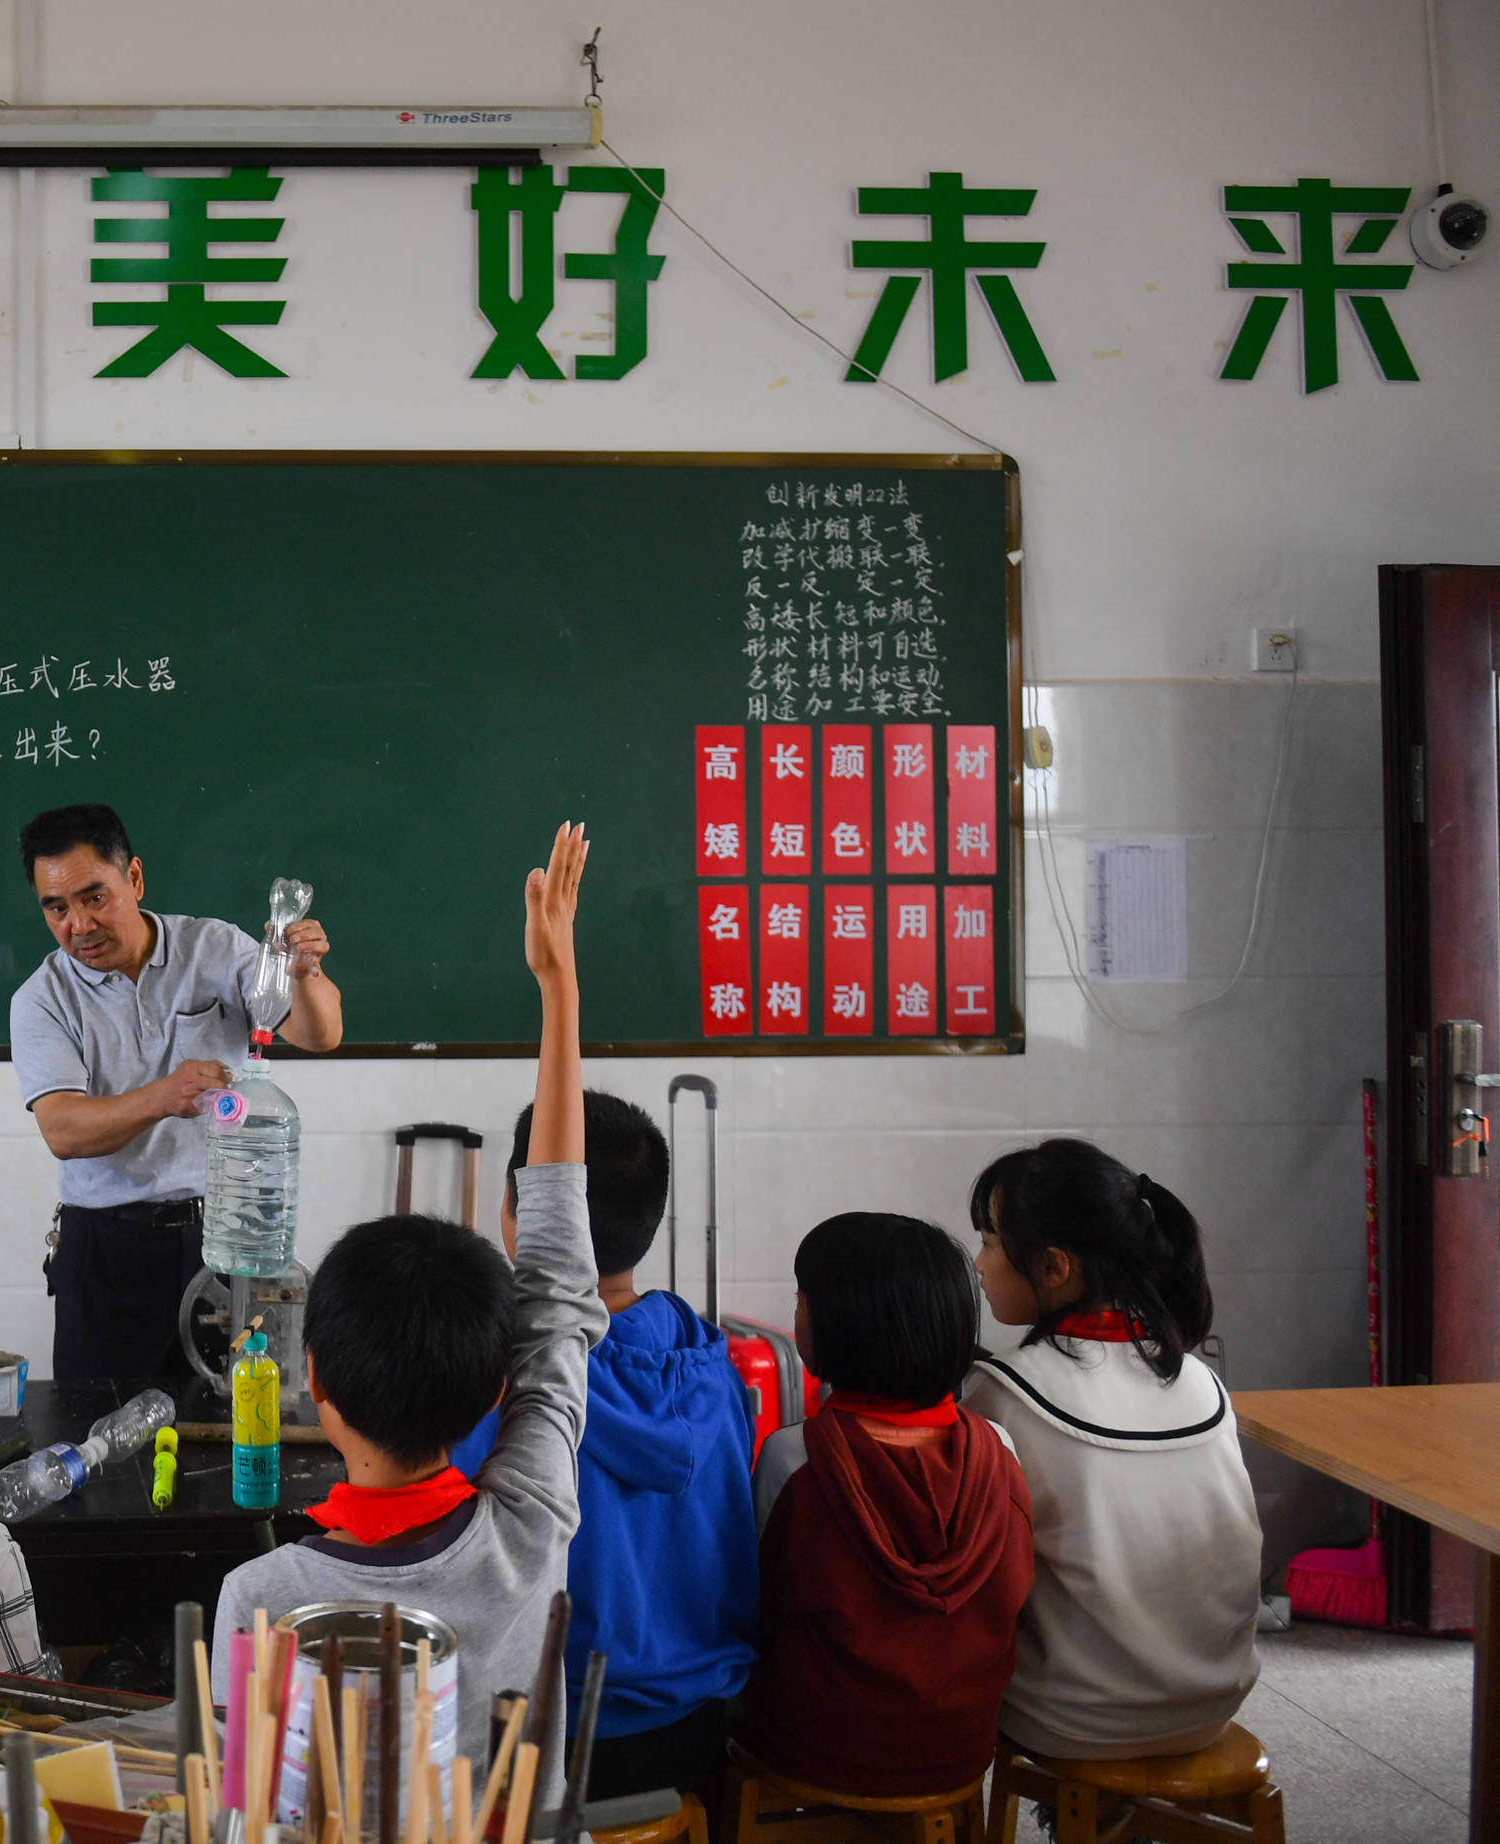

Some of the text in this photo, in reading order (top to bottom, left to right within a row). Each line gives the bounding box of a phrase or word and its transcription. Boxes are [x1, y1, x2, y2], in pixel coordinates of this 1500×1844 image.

[422, 111, 513, 125] ThreeStars
[765, 479, 910, 511] 创新发明22法
[703, 744, 740, 860] 高矮
[769, 743, 806, 858] 长短
[830, 744, 865, 858] 颜色
[892, 743, 928, 857] 形状
[955, 744, 990, 858] 材料
[708, 904, 746, 1019] 名称
[767, 903, 802, 1018] 结构
[832, 904, 866, 1018] 运动
[896, 905, 929, 1017] 用途
[953, 905, 988, 1014] 加工
